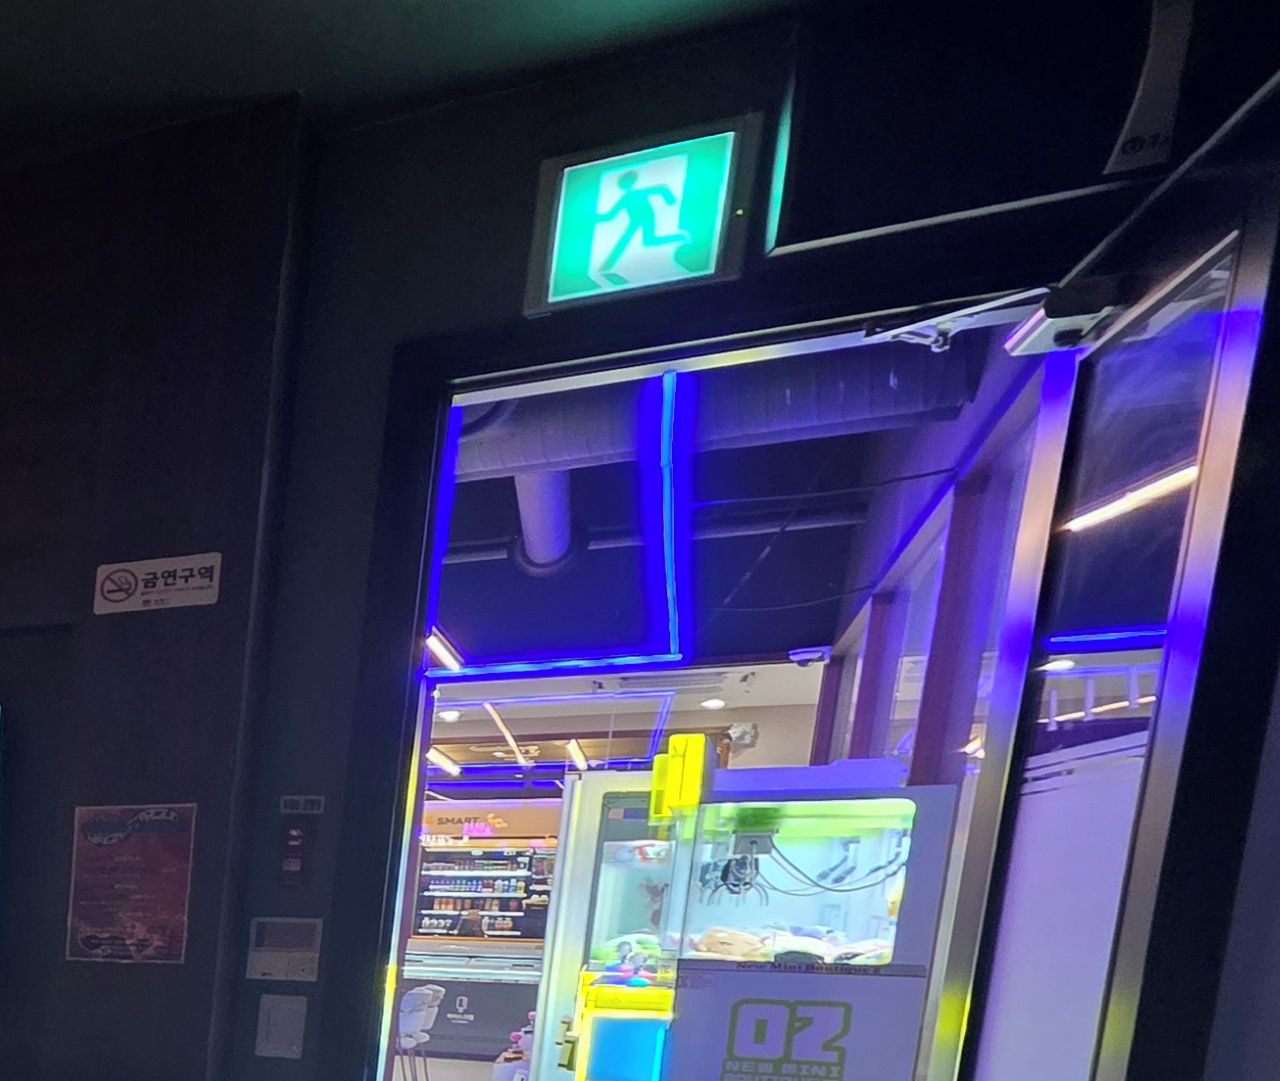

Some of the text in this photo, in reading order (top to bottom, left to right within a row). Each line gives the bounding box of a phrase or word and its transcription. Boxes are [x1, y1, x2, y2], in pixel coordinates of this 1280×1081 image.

[141, 565, 215, 589] 금연구역
[437, 816, 480, 826] SMART
[737, 962, 767, 971] New
[770, 962, 802, 972] Mini
[729, 1000, 851, 1063] 02
[725, 1060, 841, 1077] NEW MINI
